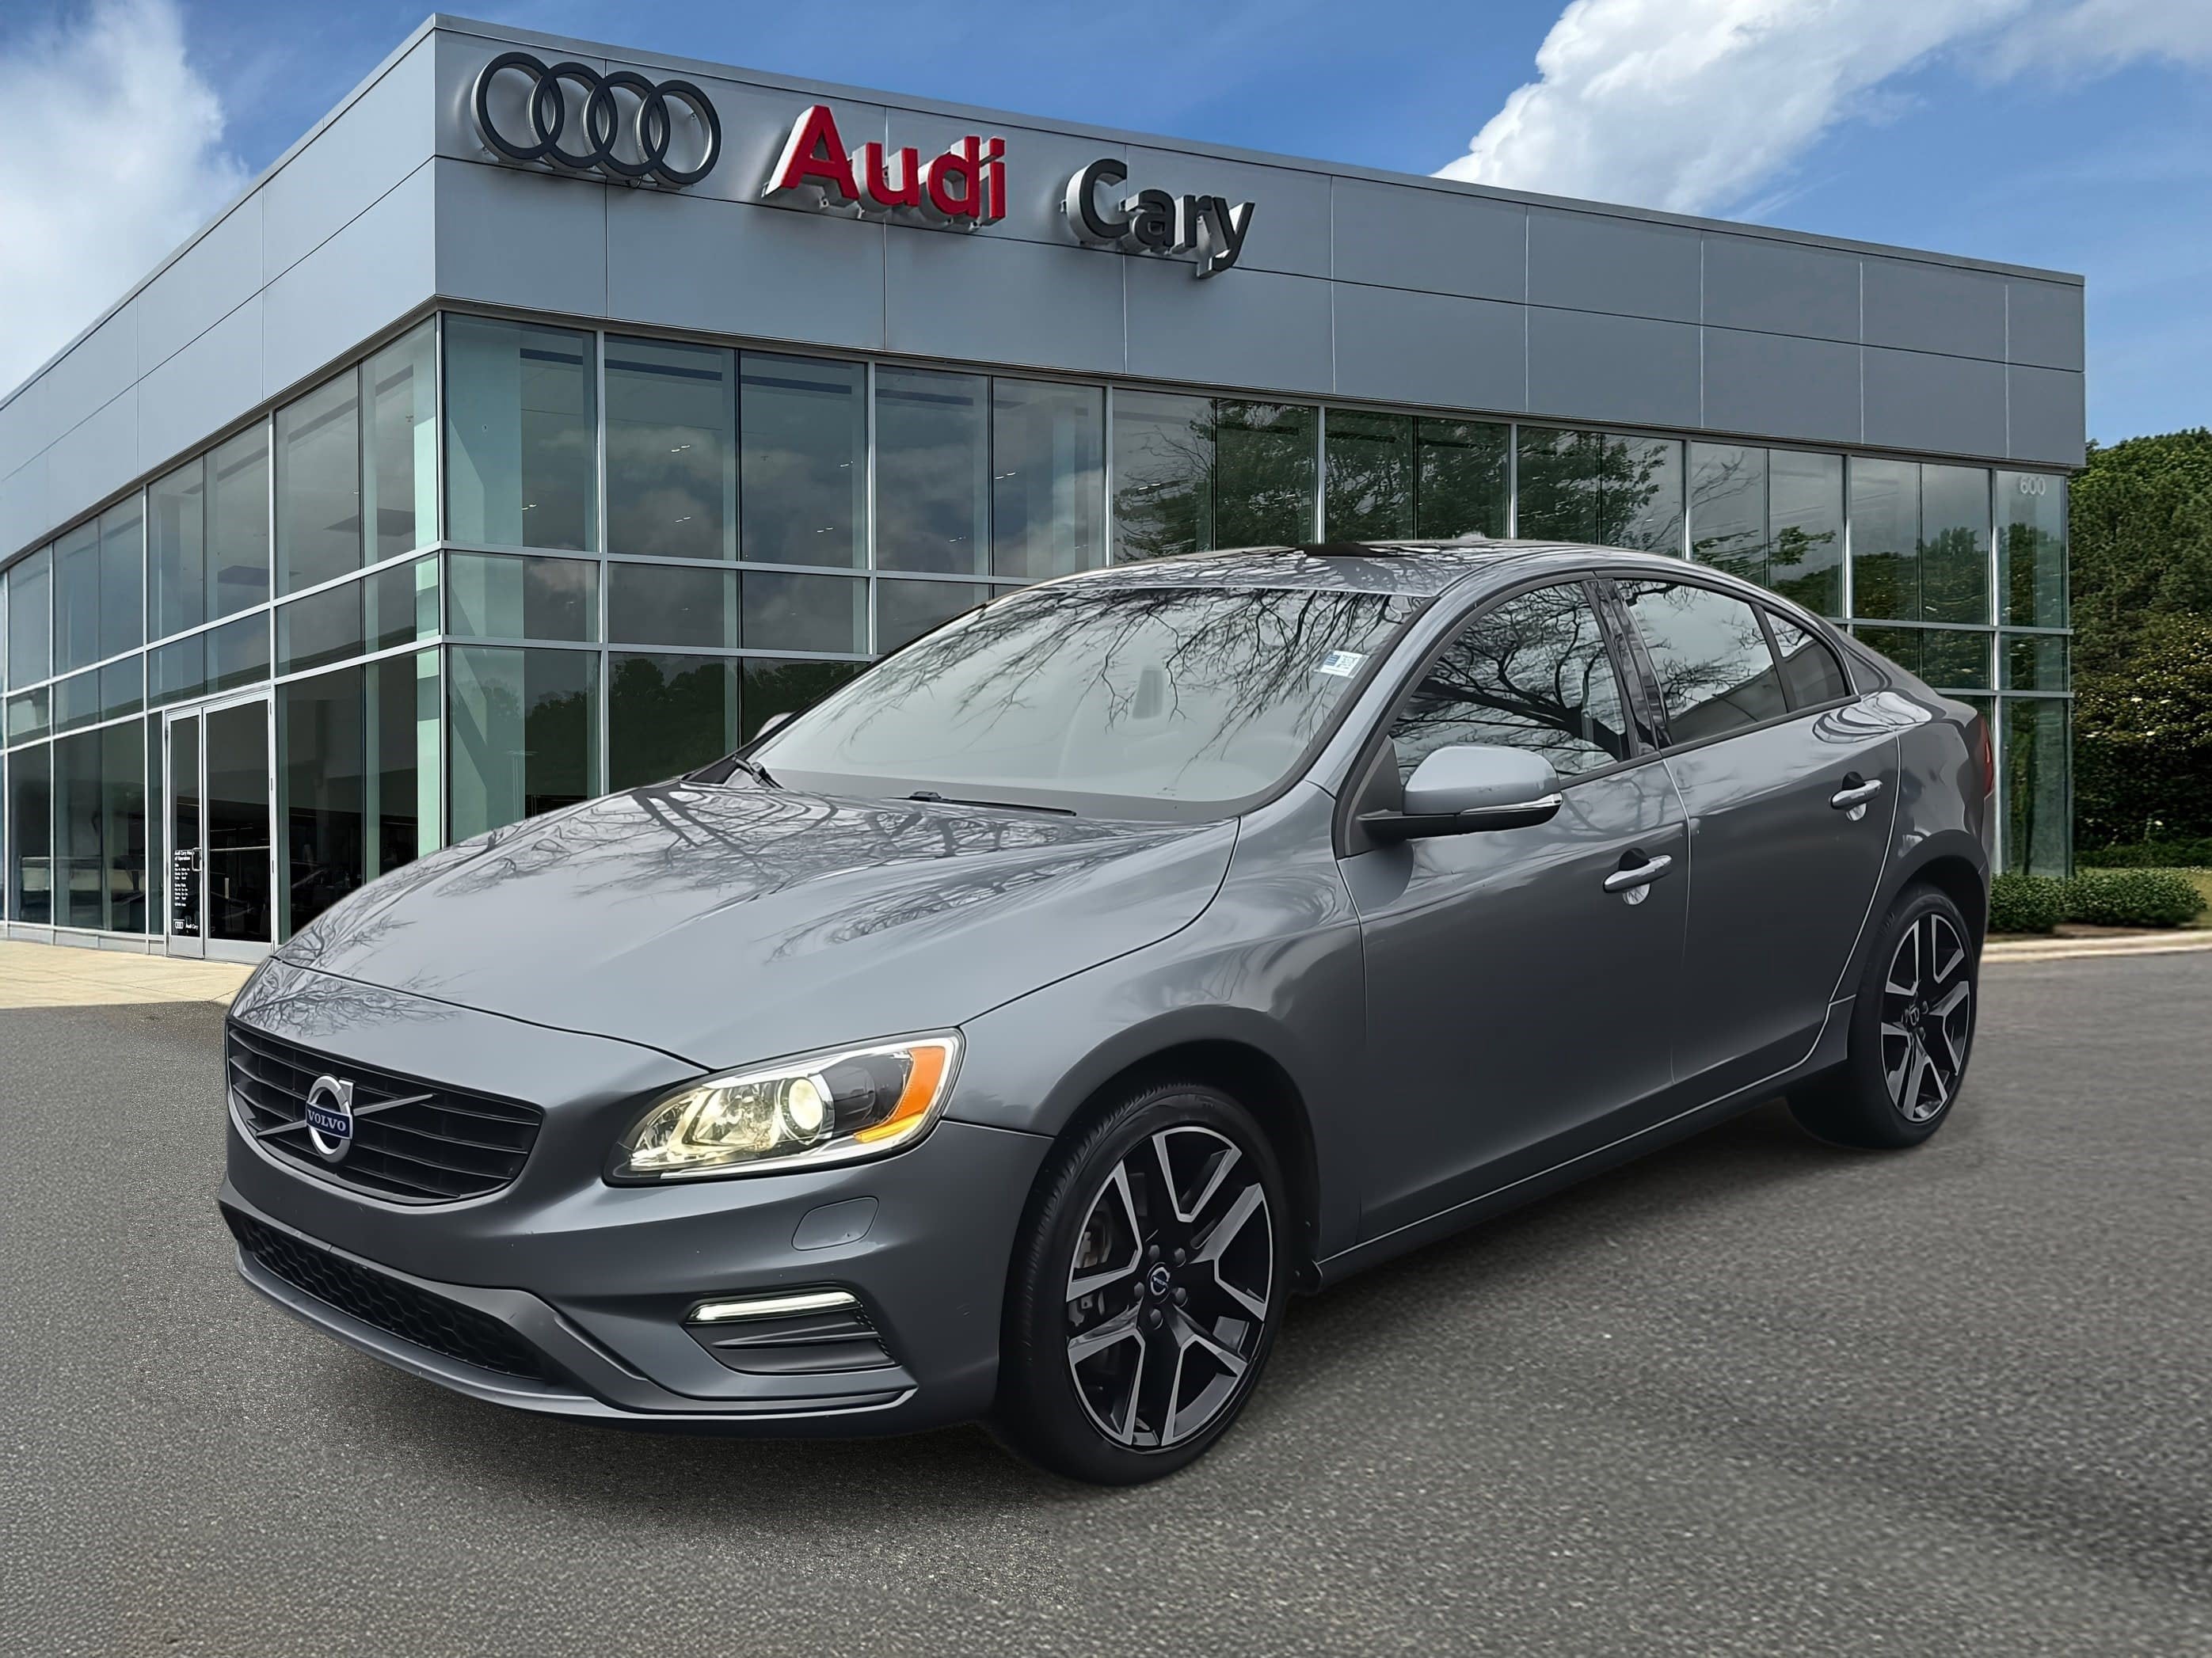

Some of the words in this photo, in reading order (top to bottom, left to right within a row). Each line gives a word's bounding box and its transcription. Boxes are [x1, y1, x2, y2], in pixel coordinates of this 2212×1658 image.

[772, 105, 1007, 221] Audi
[1071, 158, 1255, 274] Cary
[2020, 477, 2046, 495] 600
[307, 1109, 346, 1131] VOLVO
